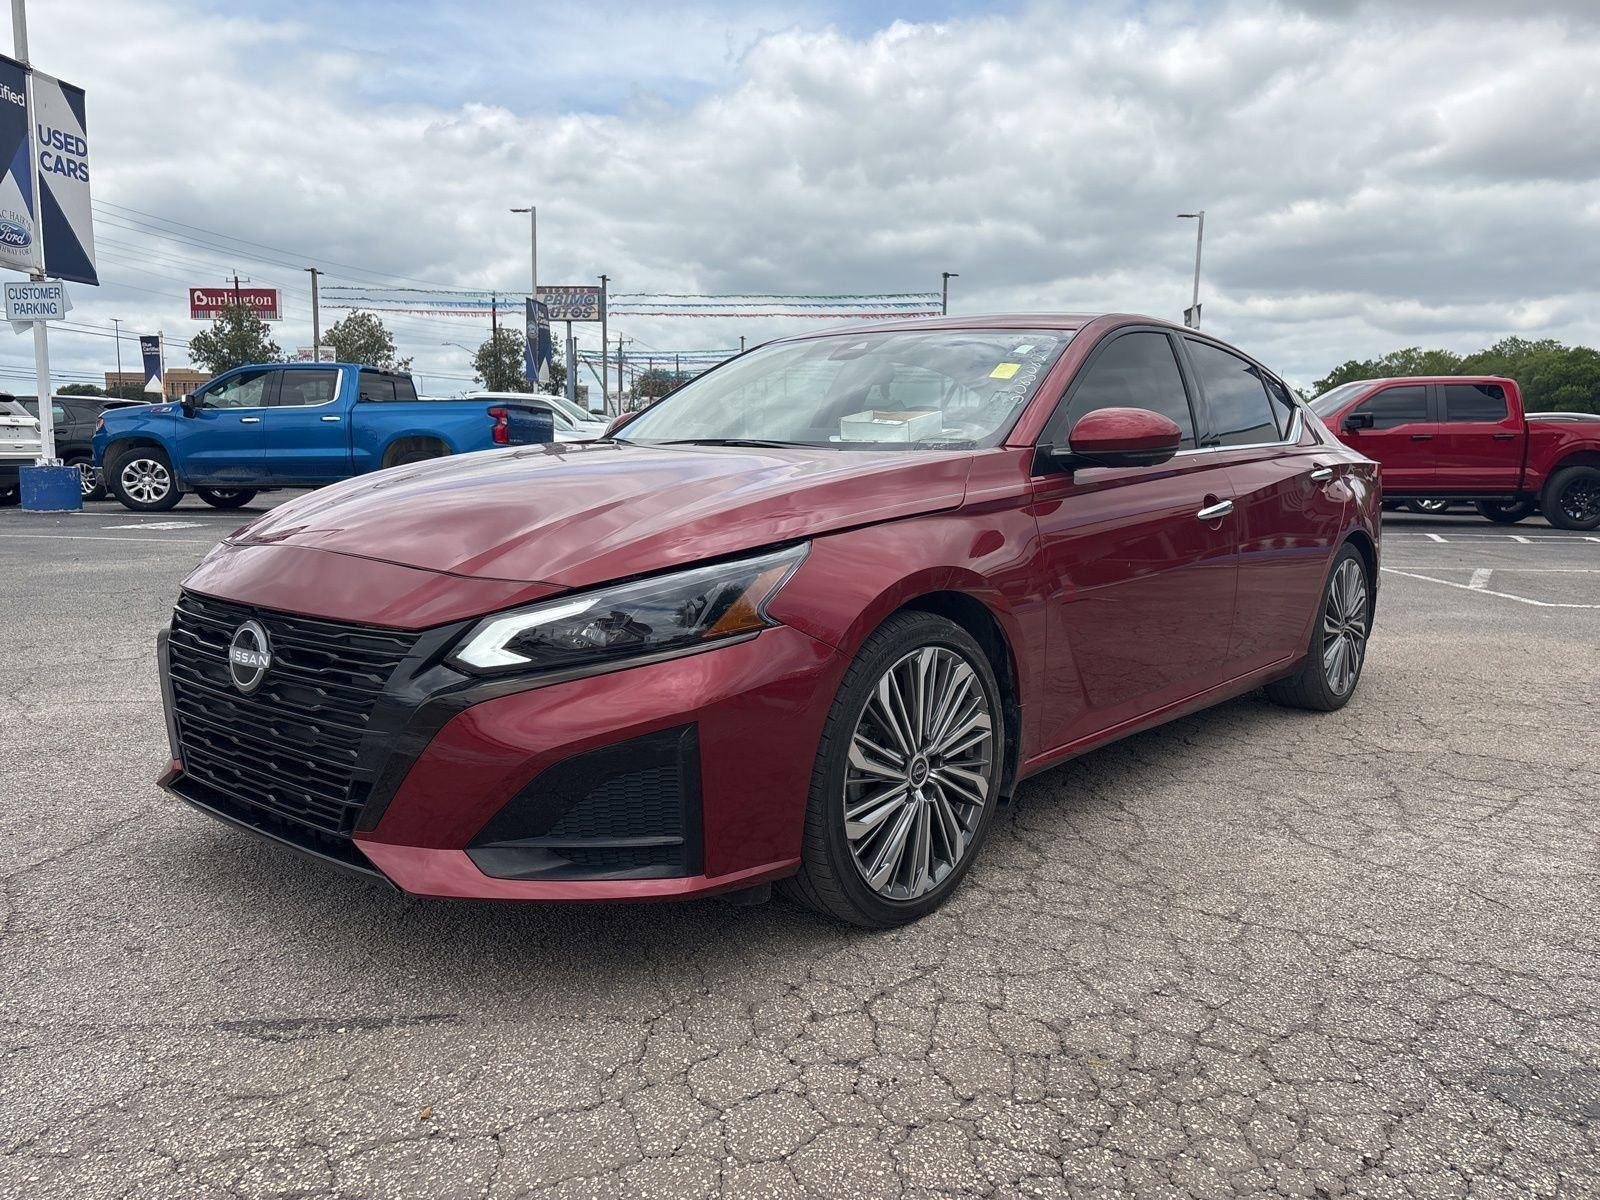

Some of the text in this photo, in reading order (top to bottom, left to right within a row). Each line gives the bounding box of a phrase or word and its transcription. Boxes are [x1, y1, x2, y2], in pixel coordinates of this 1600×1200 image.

[0, 83, 25, 107] ified
[38, 124, 88, 157] USED
[40, 151, 90, 182] CARS
[0, 222, 26, 245] Ford
[8, 287, 61, 300] CUSTOMER
[194, 290, 273, 306] Burlington
[13, 302, 58, 315] PARKING
[548, 306, 594, 318] UTOS
